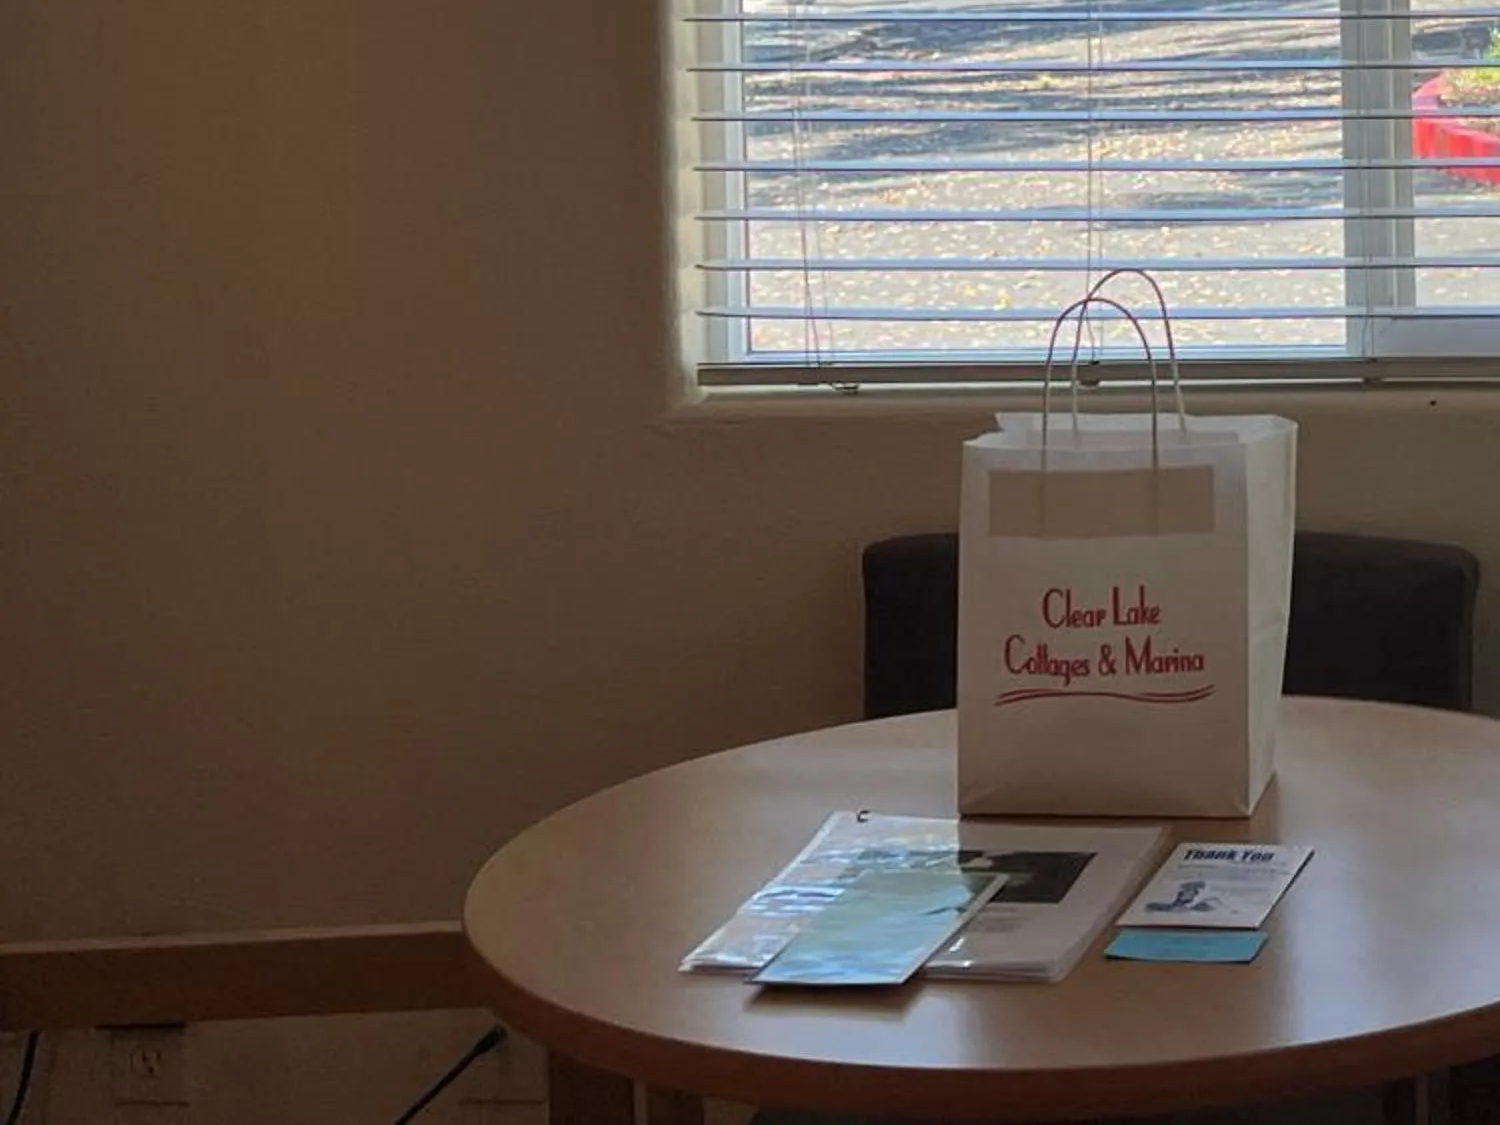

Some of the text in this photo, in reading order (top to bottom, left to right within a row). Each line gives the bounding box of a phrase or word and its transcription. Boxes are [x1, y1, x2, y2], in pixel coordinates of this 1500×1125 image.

[1042, 586, 1161, 629] Clear Lake
[1005, 634, 1205, 686] Cottages & Marina
[1184, 849, 1276, 862] Thank You
